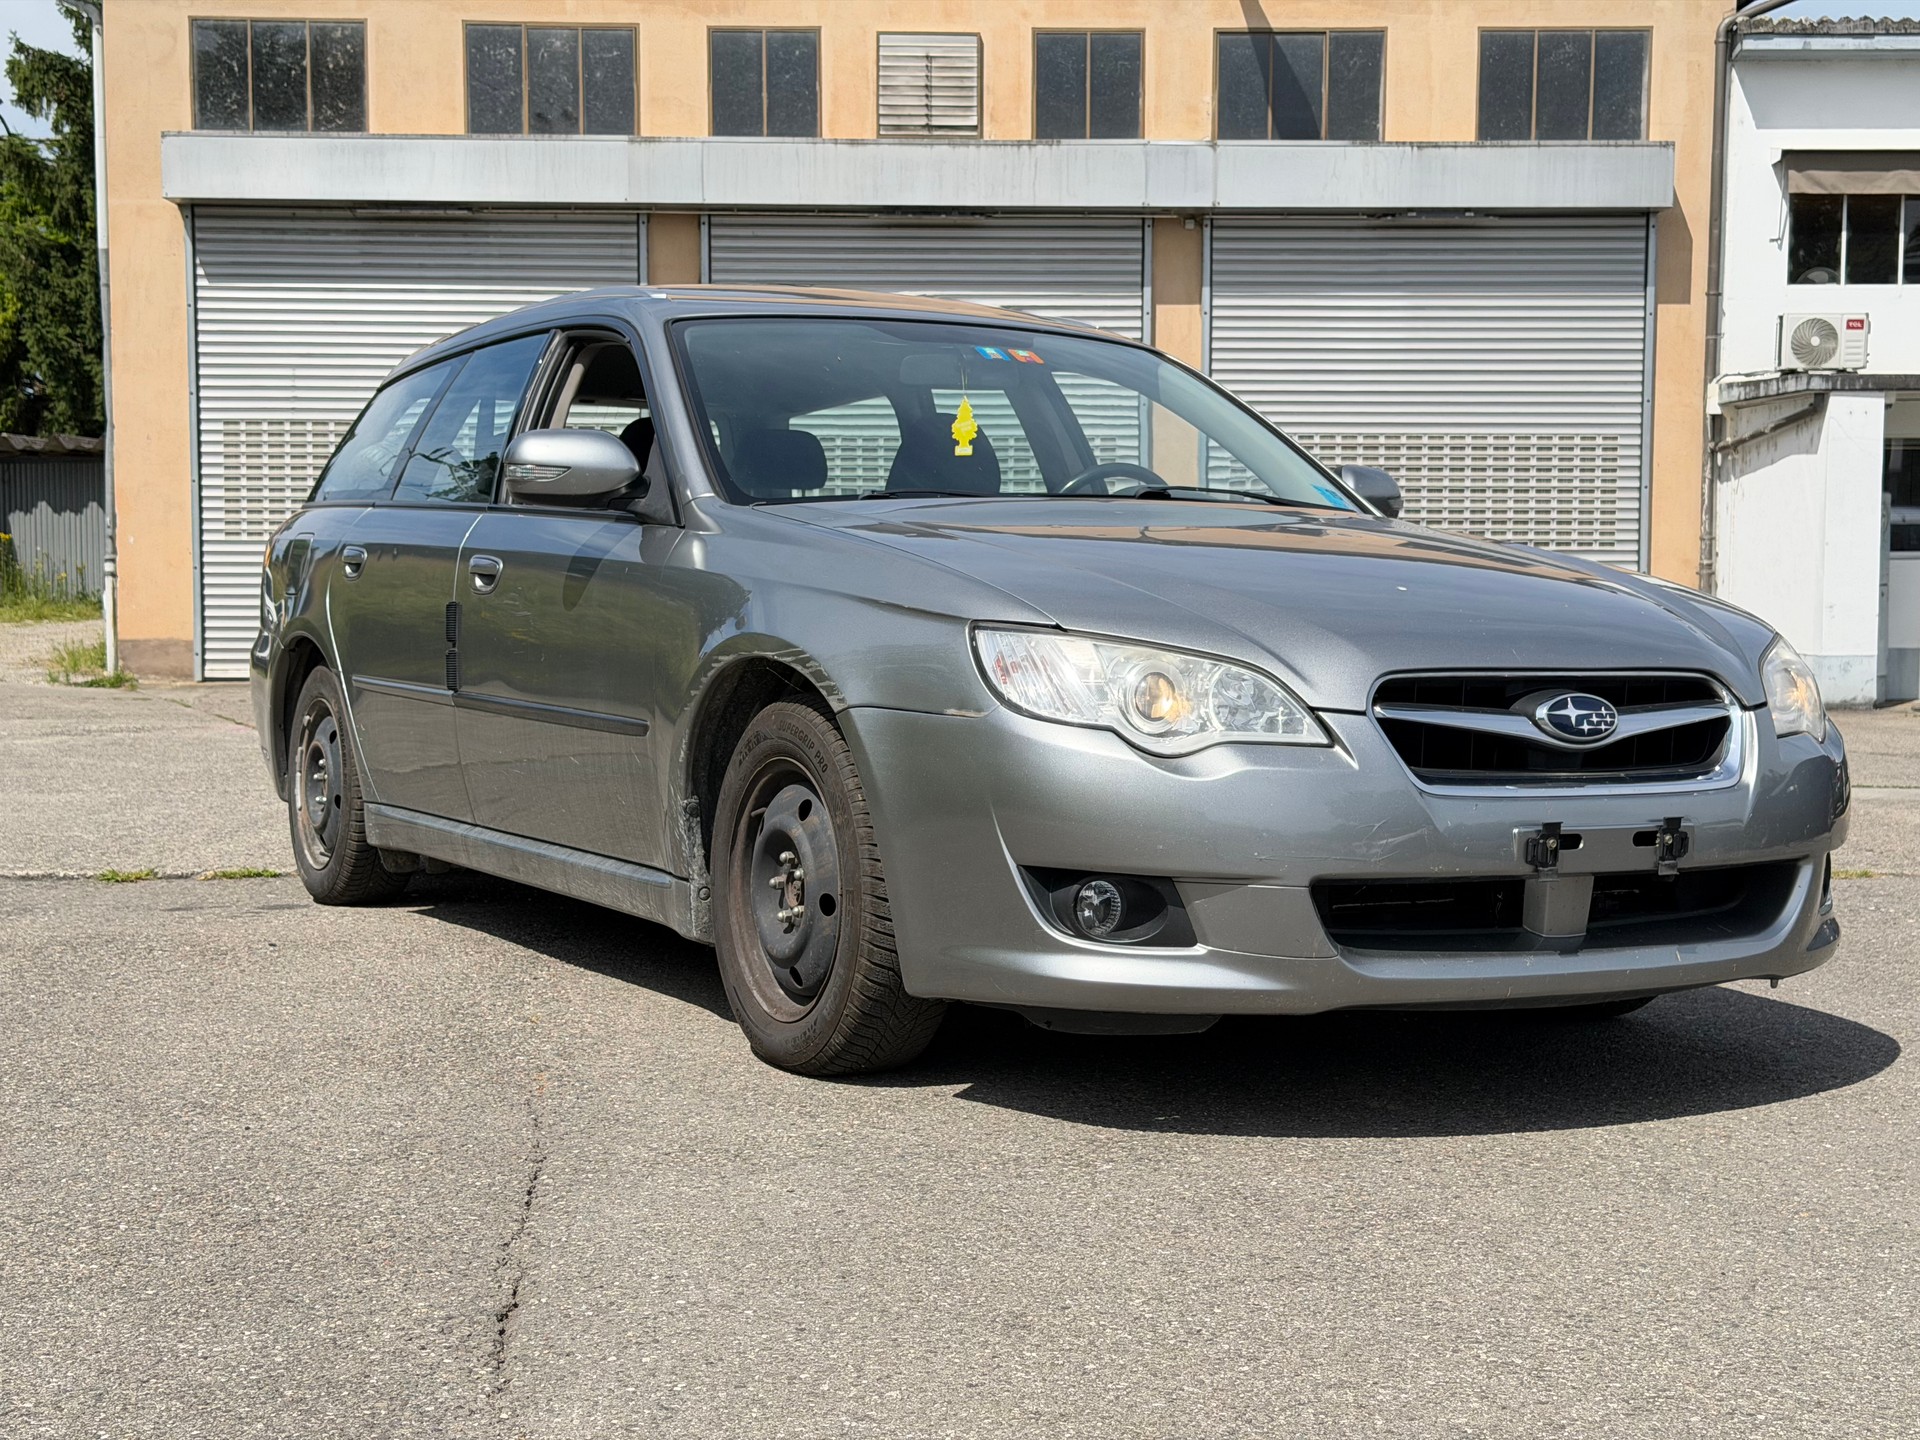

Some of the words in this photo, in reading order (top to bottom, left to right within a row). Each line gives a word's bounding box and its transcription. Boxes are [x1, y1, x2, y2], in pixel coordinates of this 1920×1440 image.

[1847, 320, 1863, 328] TCL
[778, 720, 815, 750] SUPERGRIP
[814, 750, 828, 774] PRO
